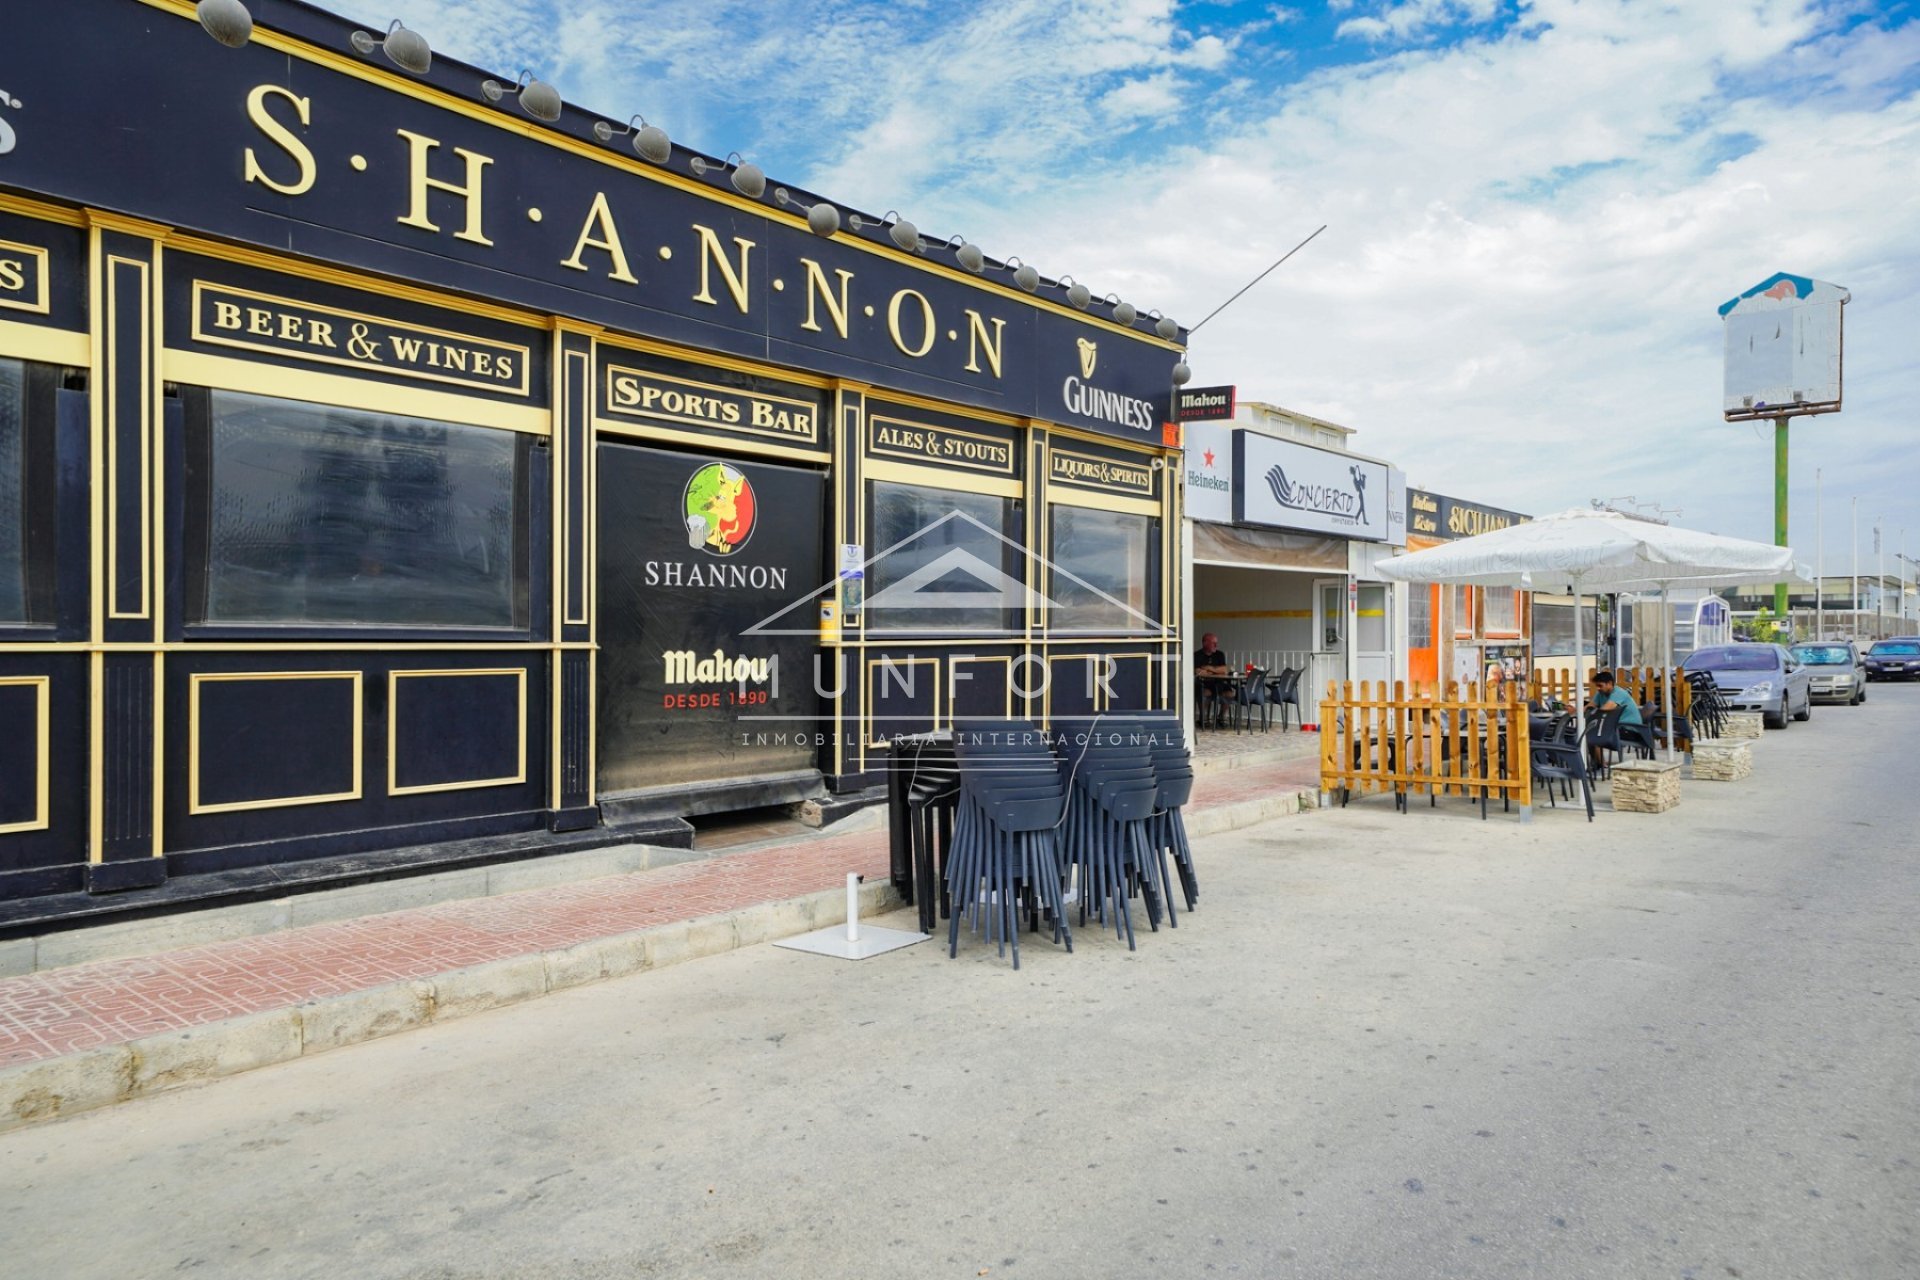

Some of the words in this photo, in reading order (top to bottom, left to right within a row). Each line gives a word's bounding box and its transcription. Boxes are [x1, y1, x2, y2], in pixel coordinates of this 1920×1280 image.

[213, 301, 337, 348] BEER
[347, 322, 382, 360] &
[388, 336, 513, 379] WINES
[614, 377, 740, 423] SPORTS
[751, 400, 811, 434] BAR
[1063, 375, 1154, 432] GUINNESS
[1181, 393, 1226, 408] Mahou
[877, 427, 923, 450] ALES
[926, 431, 941, 456] &
[944, 439, 1007, 463] STOUTS
[1054, 457, 1100, 479] LIQUORS
[1100, 462, 1110, 483] &
[1110, 467, 1148, 487] SPIRITS
[1187, 470, 1229, 492] Heineken
[1288, 480, 1354, 513] CONCIERTO
[645, 561, 788, 590] SHANNON
[662, 649, 769, 684] Mahou
[663, 695, 721, 708] DESDE
[729, 691, 768, 705] 1890
